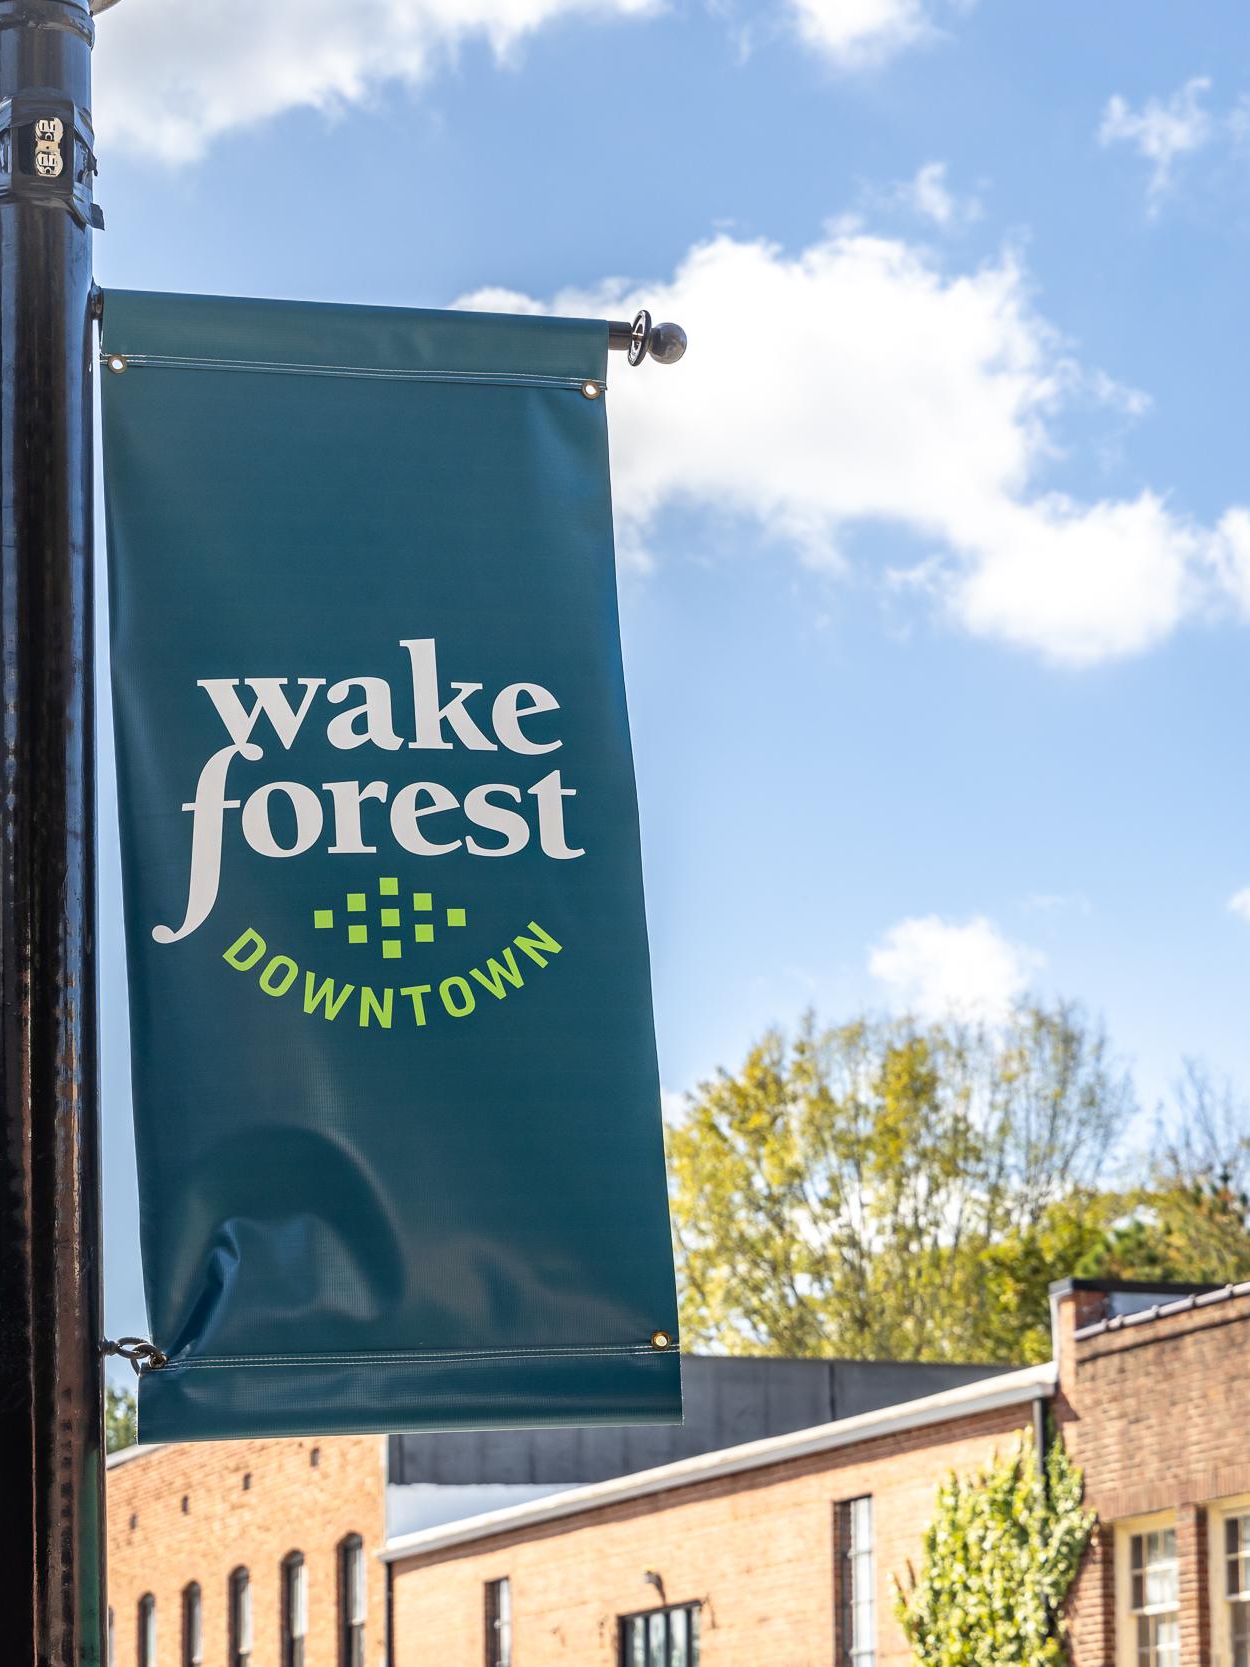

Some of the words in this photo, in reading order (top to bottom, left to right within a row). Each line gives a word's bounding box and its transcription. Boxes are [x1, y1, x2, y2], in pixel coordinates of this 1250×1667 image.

[196, 637, 564, 756] wake
[151, 742, 586, 945] forest
[222, 921, 563, 1029] DOWNTOWN
